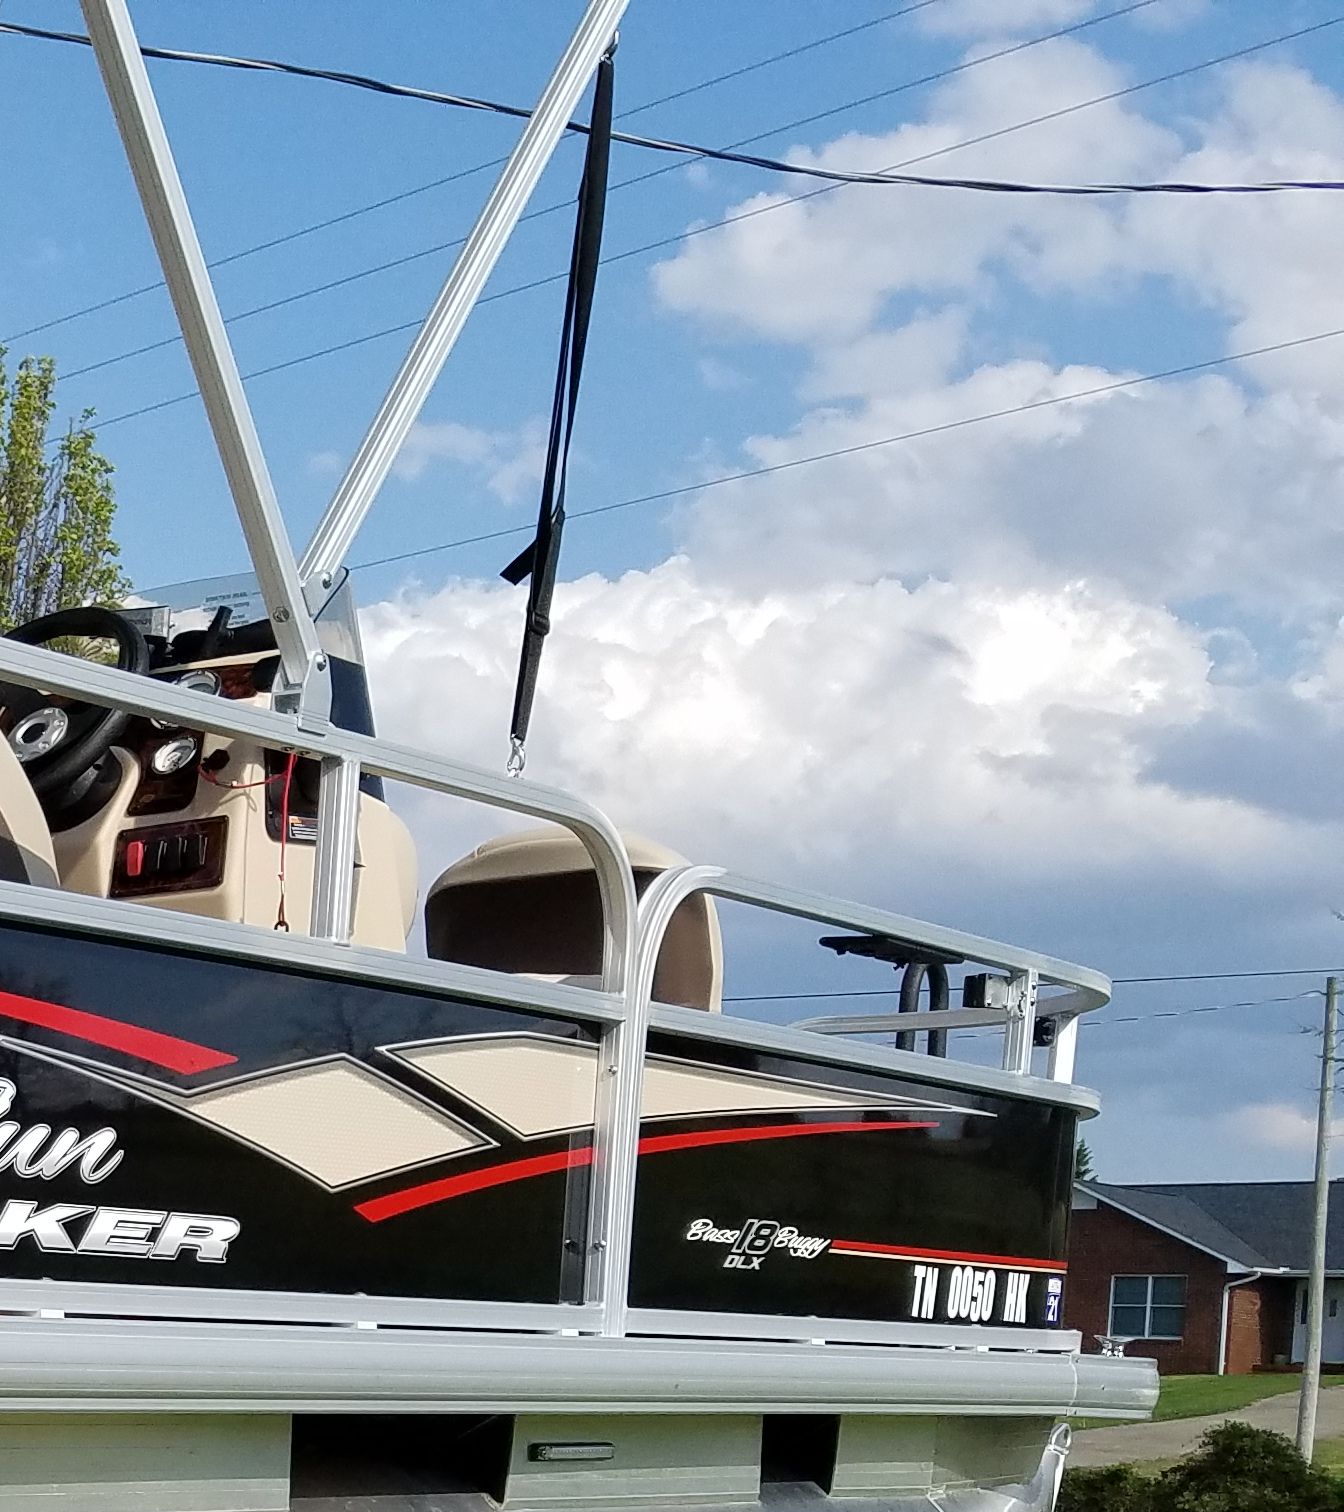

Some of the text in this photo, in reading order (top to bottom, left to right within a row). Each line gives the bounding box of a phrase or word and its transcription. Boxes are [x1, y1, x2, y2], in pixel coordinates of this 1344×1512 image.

[686, 1218, 832, 1259] Bass 18 Buggy
[723, 1254, 766, 1270] DLX
[911, 1264, 940, 1320] TN
[947, 1265, 996, 1322] 0050
